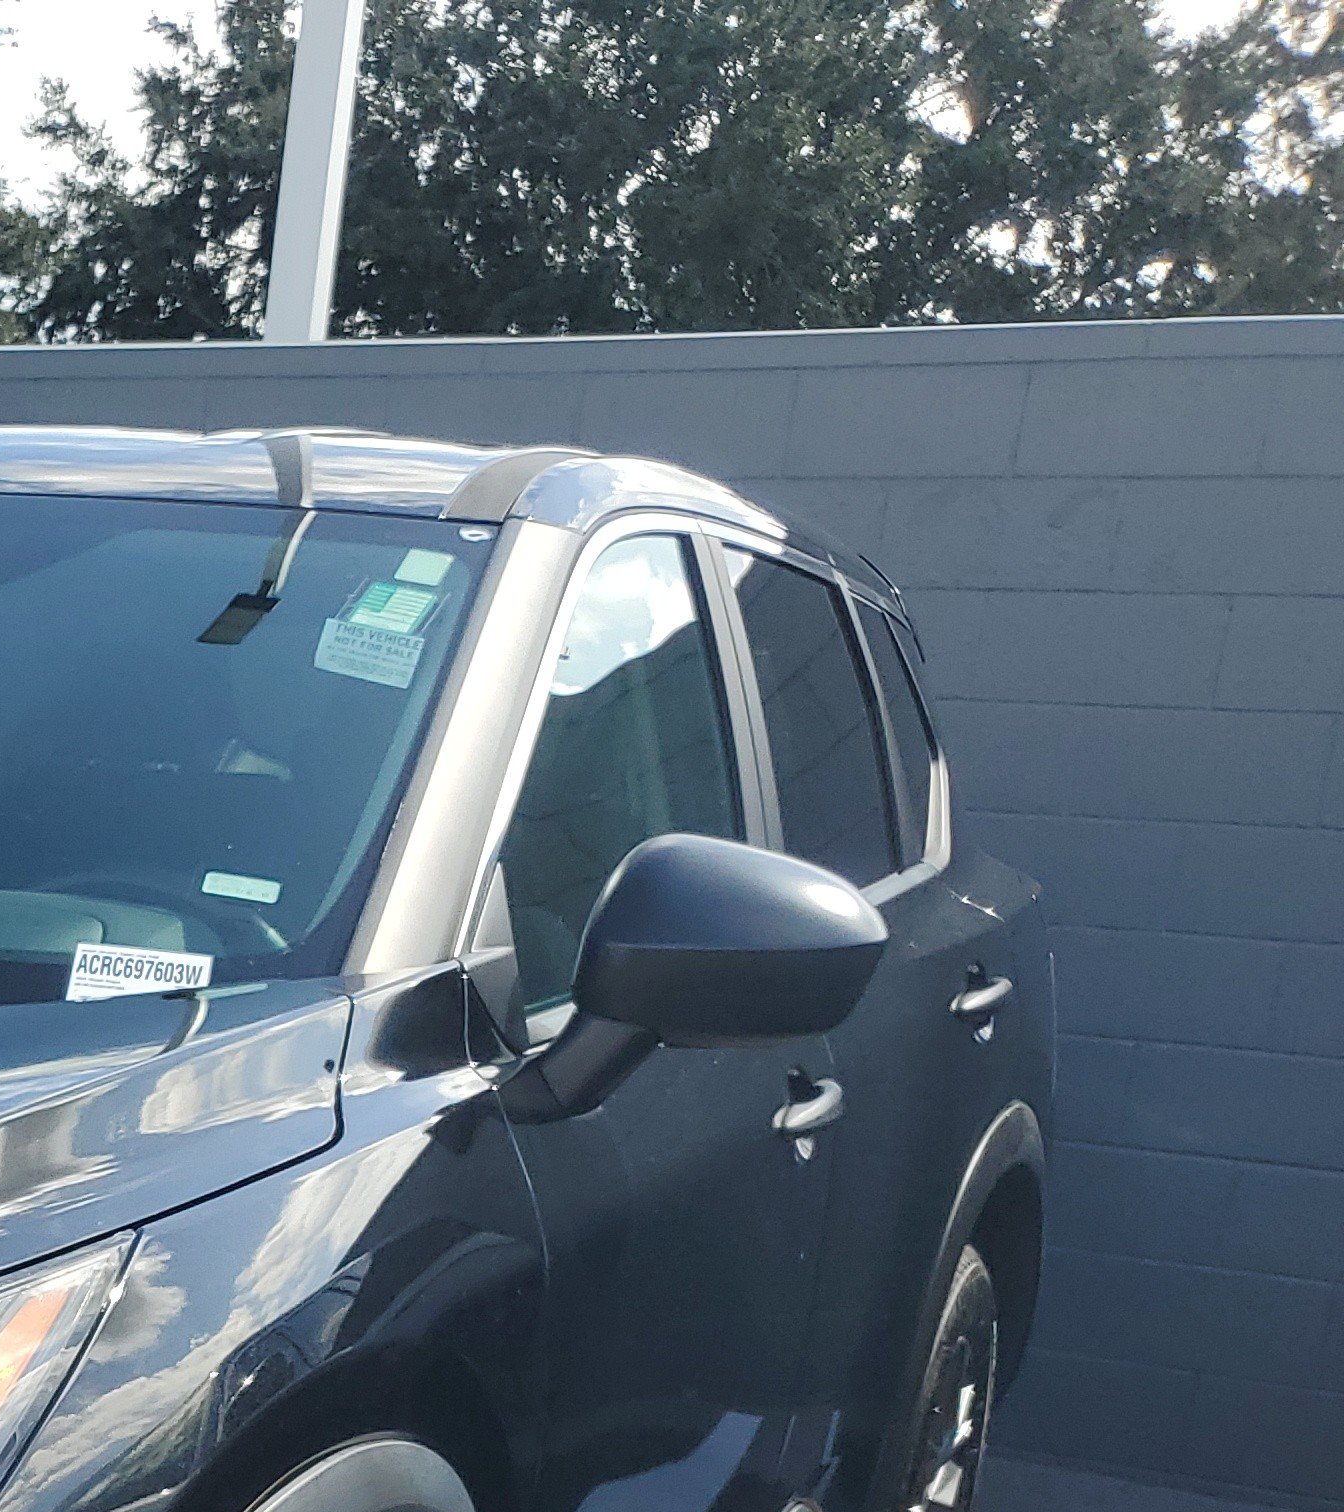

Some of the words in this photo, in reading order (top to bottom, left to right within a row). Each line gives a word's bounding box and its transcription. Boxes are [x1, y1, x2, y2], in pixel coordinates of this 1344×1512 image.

[336, 623, 365, 637] THIS
[368, 628, 423, 651] VEHICLE
[360, 640, 383, 652] FOR
[385, 646, 416, 659] SALE
[75, 953, 204, 986] ACRC697603W
